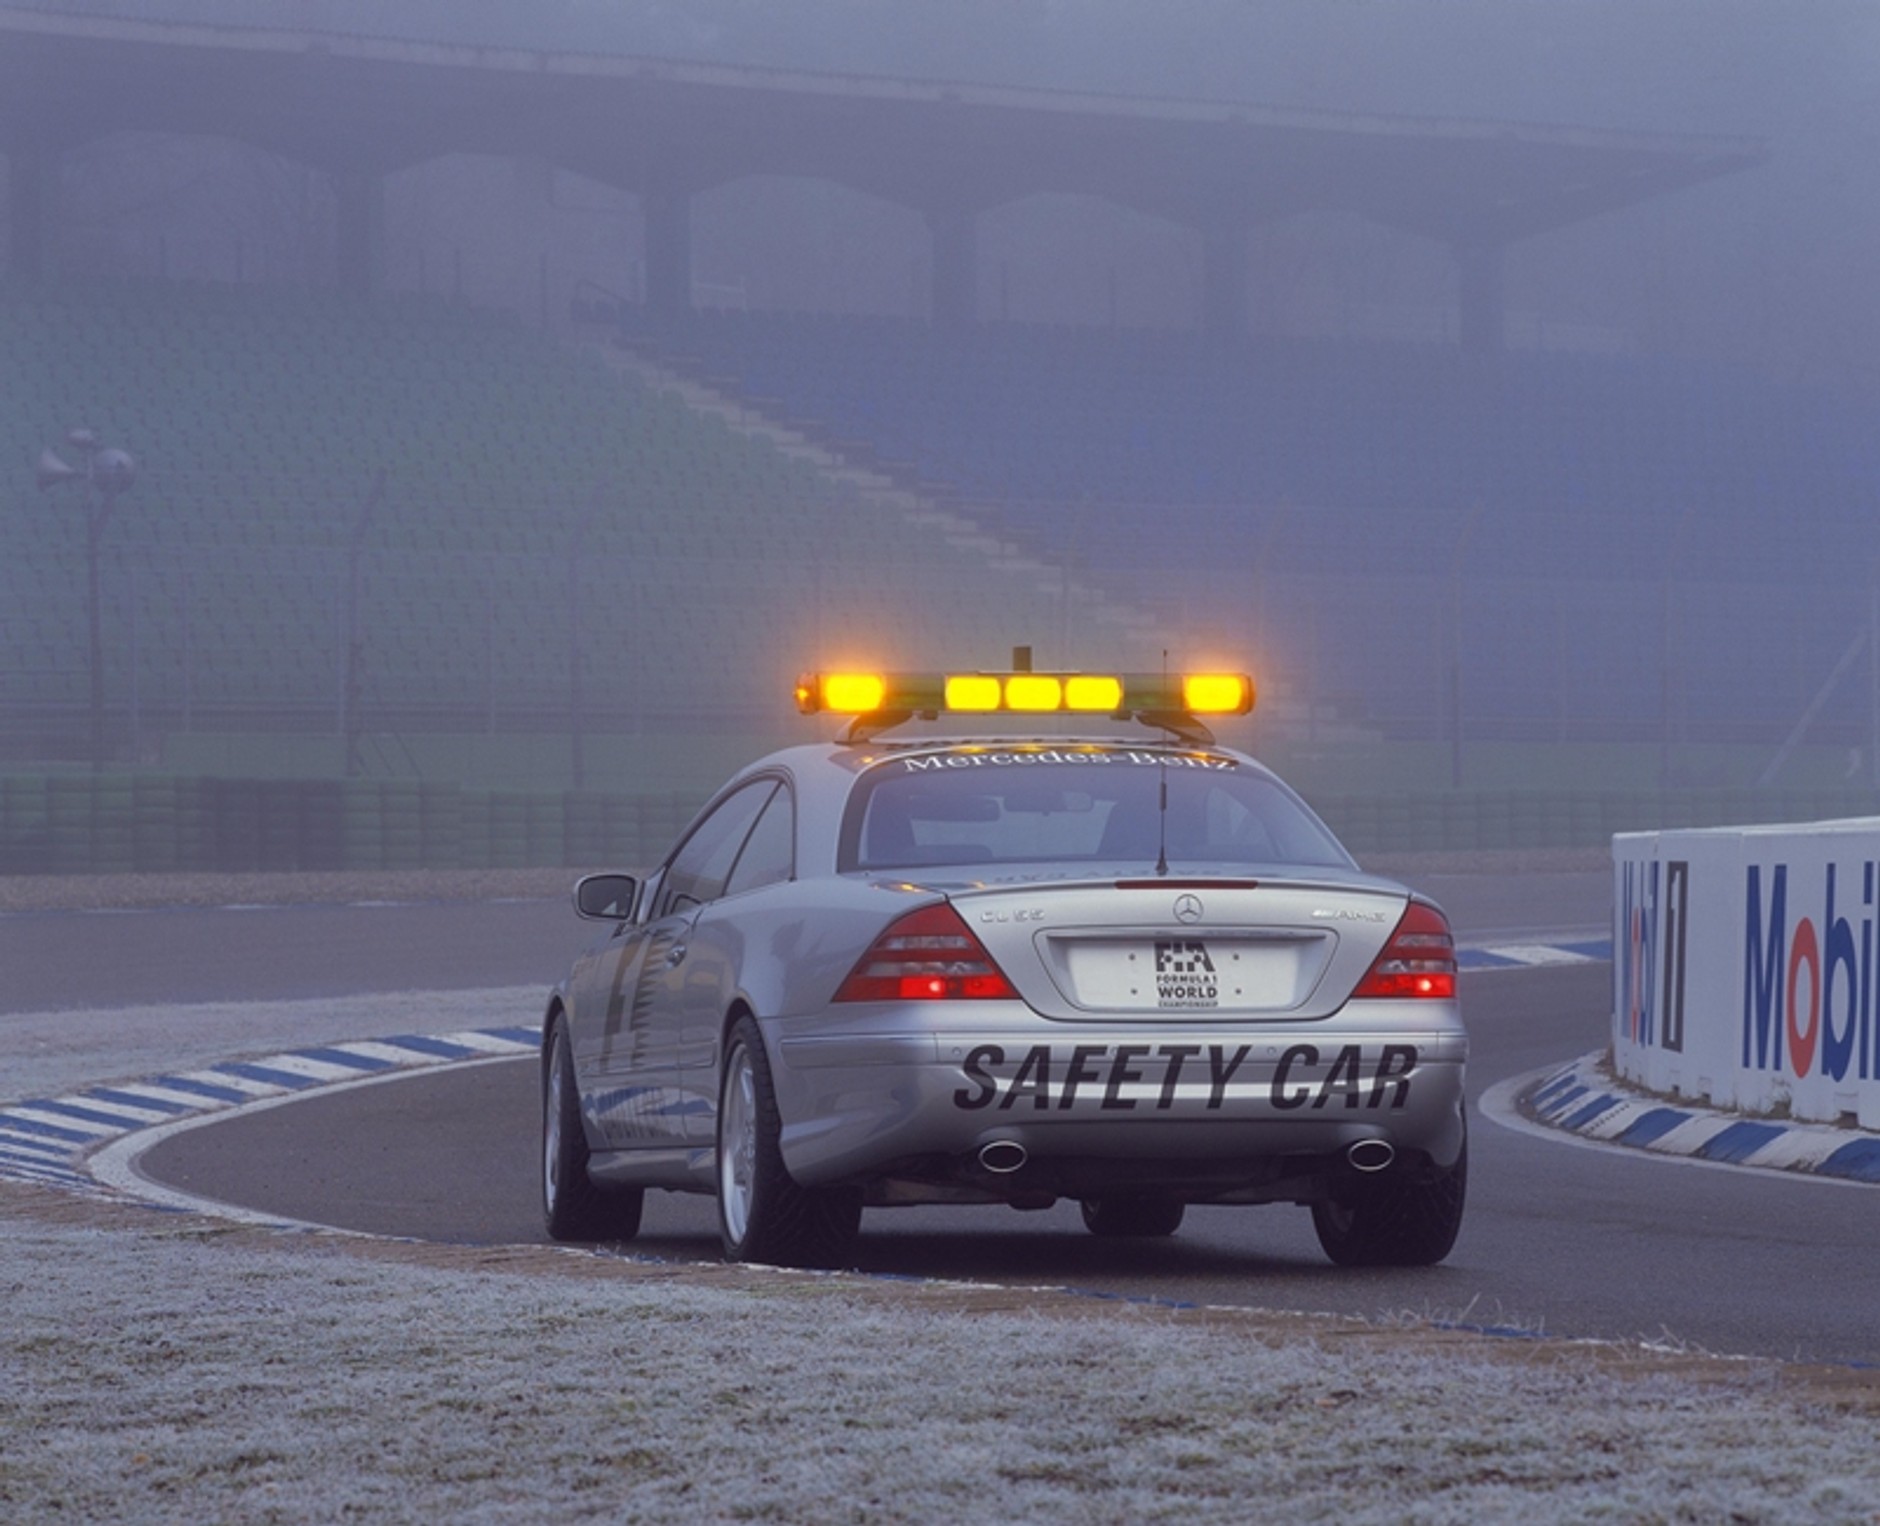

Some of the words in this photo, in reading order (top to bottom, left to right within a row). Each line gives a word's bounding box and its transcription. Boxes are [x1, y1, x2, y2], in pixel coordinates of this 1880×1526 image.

[904, 750, 1236, 772] Mercedes-Benz
[1156, 974, 1210, 984] FORMULA
[1158, 986, 1218, 999] WORLD
[953, 1044, 1253, 1111] SAFETY
[1269, 1044, 1418, 1111] CAR
